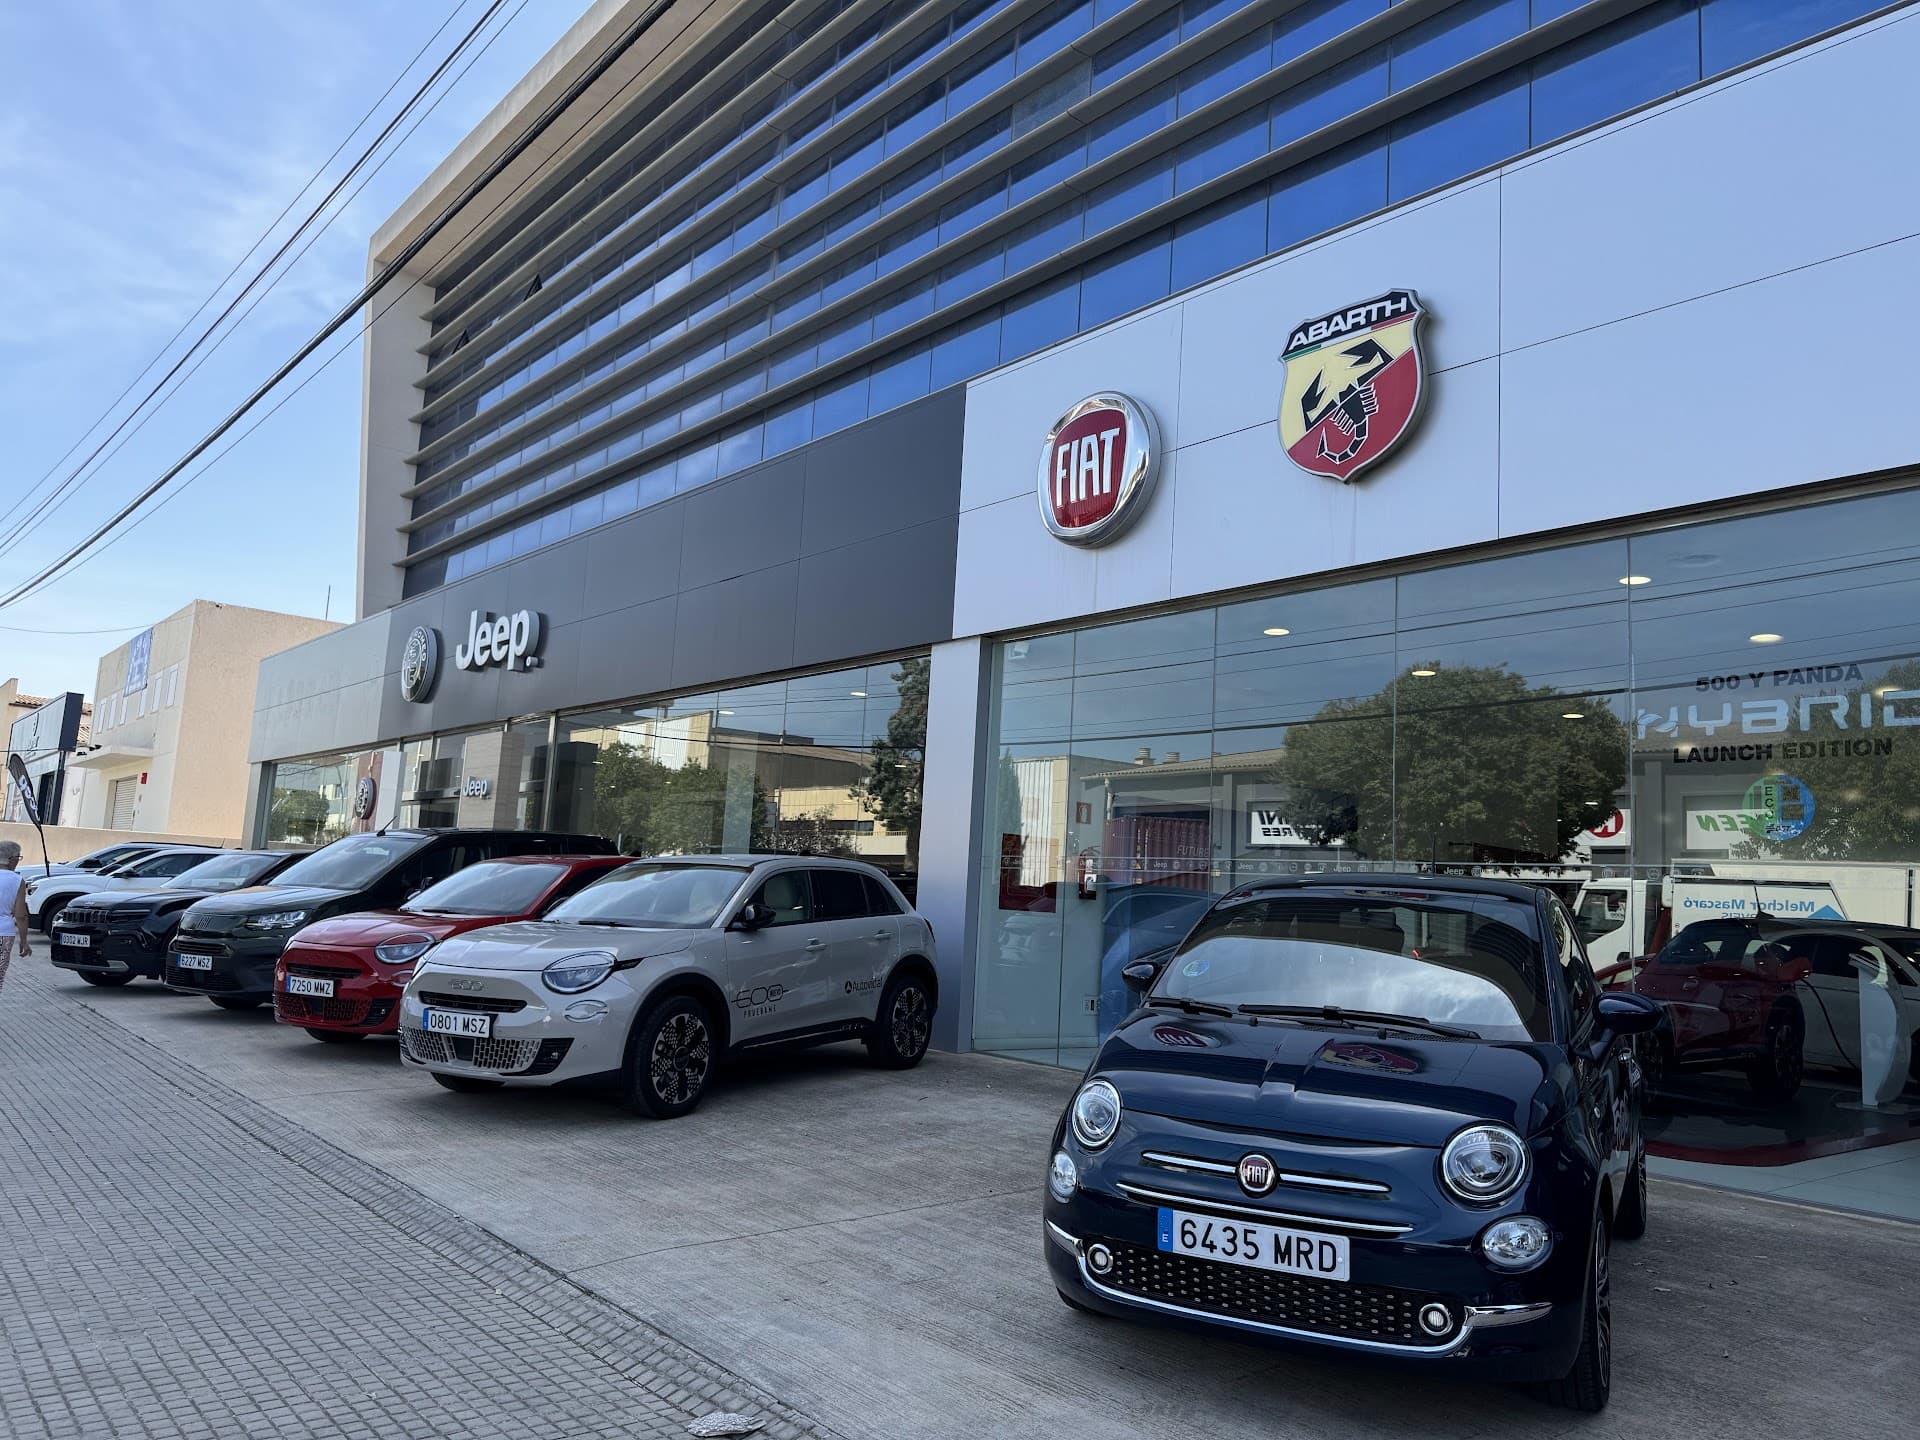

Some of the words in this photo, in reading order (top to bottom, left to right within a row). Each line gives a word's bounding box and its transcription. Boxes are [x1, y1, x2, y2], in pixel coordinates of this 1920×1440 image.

[1288, 296, 1408, 350] ABARTH
[1055, 426, 1121, 508] FIAT
[455, 609, 539, 671] Jeep
[1696, 674, 1741, 692] 500
[1750, 672, 1765, 687] Y
[1773, 664, 1864, 686] PANDA
[1673, 743, 1773, 764] LAUNCH
[1782, 737, 1893, 760] EDITION
[462, 776, 488, 798] Jeep
[1153, 861, 1168, 869] Jeep
[1443, 866, 1465, 876] Jeep
[291, 978, 312, 993] 7250
[430, 1013, 458, 1031] 0801
[462, 1015, 487, 1034] MSZ
[1247, 1164, 1267, 1184] FIAT
[1161, 1233, 1169, 1243] E
[1180, 1218, 1260, 1260] 6435
[1273, 1233, 1337, 1273] MRD
